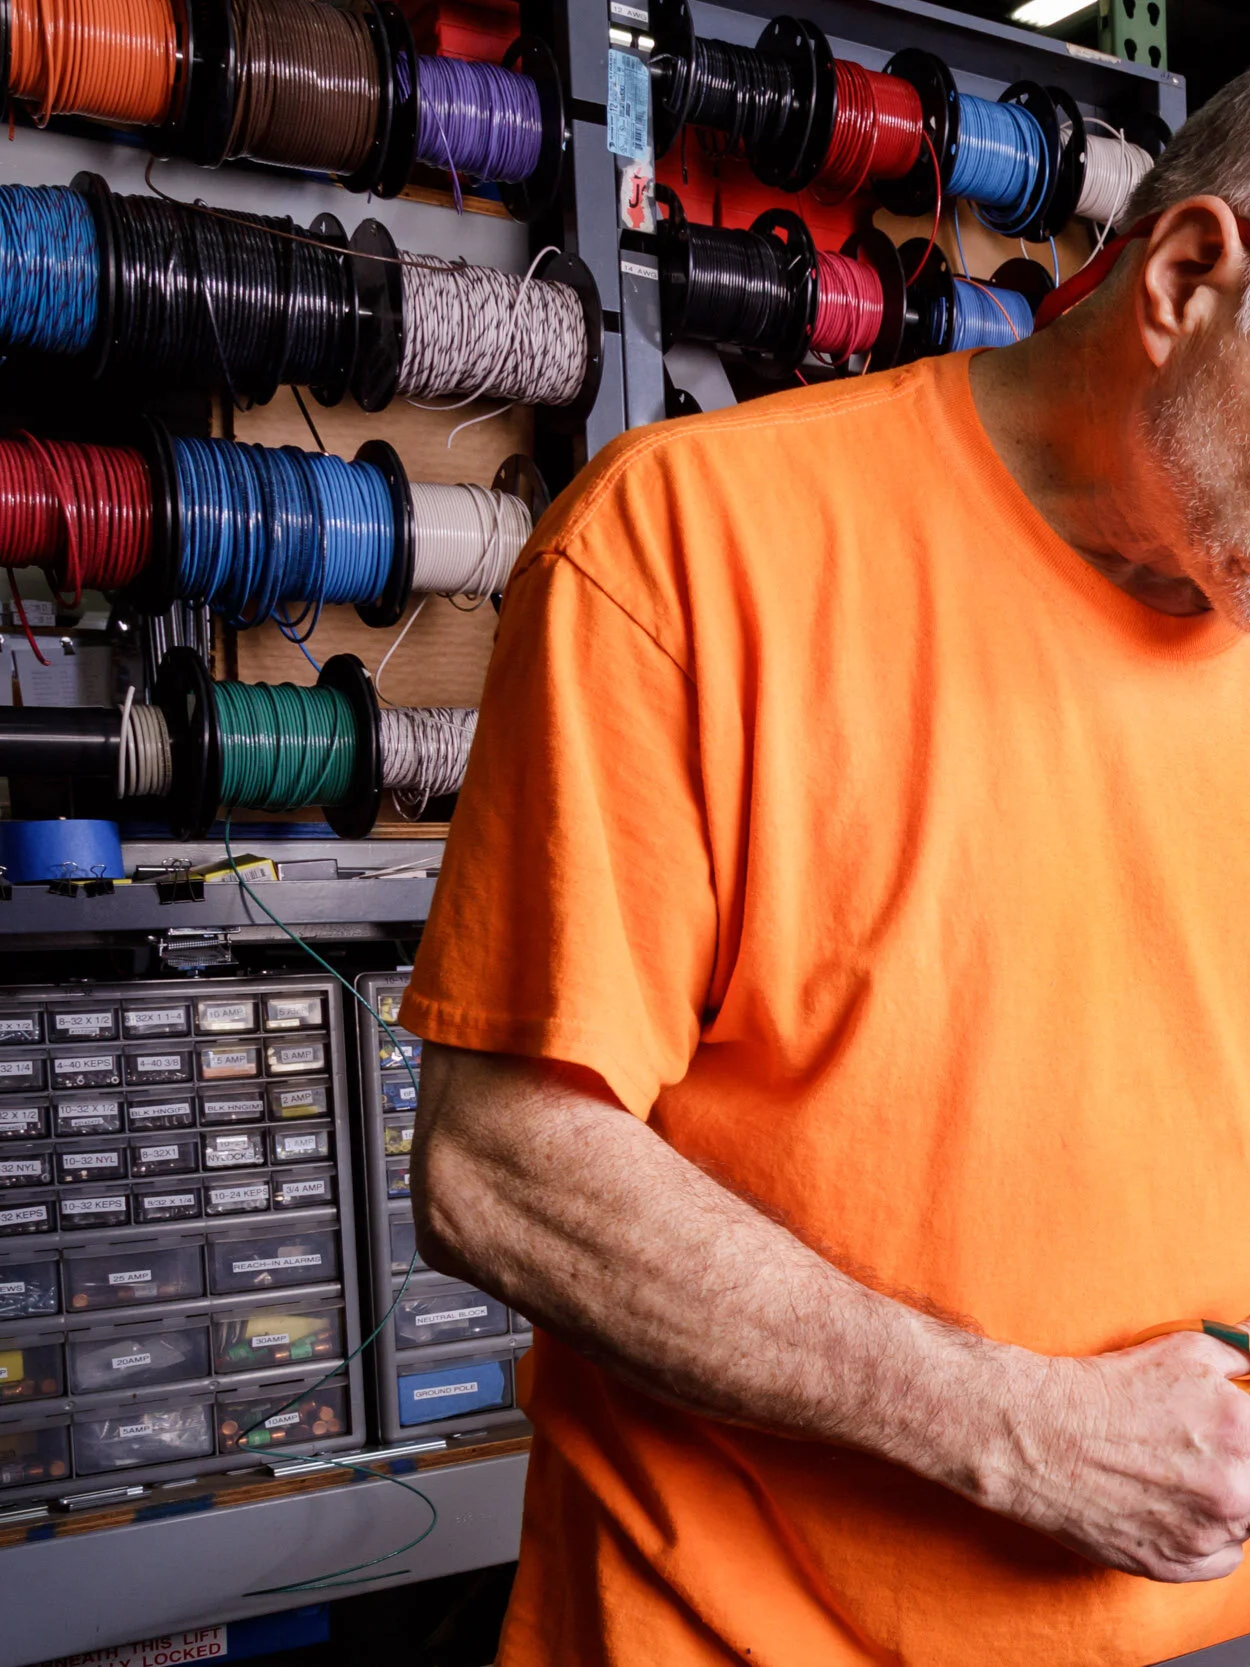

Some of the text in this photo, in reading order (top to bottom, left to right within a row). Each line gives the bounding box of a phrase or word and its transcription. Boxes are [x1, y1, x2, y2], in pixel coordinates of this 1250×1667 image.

[627, 10, 647, 21] AWG
[637, 268, 657, 278] AWG
[222, 1009, 244, 1017] AMP
[96, 1015, 110, 1024] 1/2
[226, 1054, 246, 1063] AMP
[292, 1051, 312, 1059] AMP
[57, 1059, 111, 1069] 4-40 KEPS
[140, 1057, 180, 1067] 4-40 3/8
[291, 1093, 312, 1102] AMP
[61, 1103, 116, 1114] 10-32 X 1/2
[208, 1104, 225, 1112] BLK
[23, 1111, 37, 1119] 1/2
[295, 1138, 314, 1147] AMP
[64, 1156, 116, 1166] 10-32 NYL
[16, 1163, 38, 1171] NYL
[286, 1183, 323, 1194] 3/4 AMP
[215, 1189, 268, 1200] 10-24 KEPS
[63, 1199, 122, 1211] 10-32 KEPS
[179, 1196, 192, 1204] 1/4
[15, 1209, 44, 1219] KEPS
[233, 1256, 320, 1270] REACH-IN ALARMS
[127, 1273, 149, 1281] AMP
[417, 1309, 486, 1324] NEUTRAL BLOCK
[256, 1335, 287, 1345] 30AMP
[117, 1355, 149, 1366] 20AMP
[415, 1383, 476, 1398] GROUND POLE
[266, 1415, 298, 1425] 10AMP
[123, 1425, 150, 1435] 5AMP
[131, 1636, 172, 1655] THIS
[183, 1627, 222, 1646] LIFT
[143, 1643, 222, 1667] LOCKED
